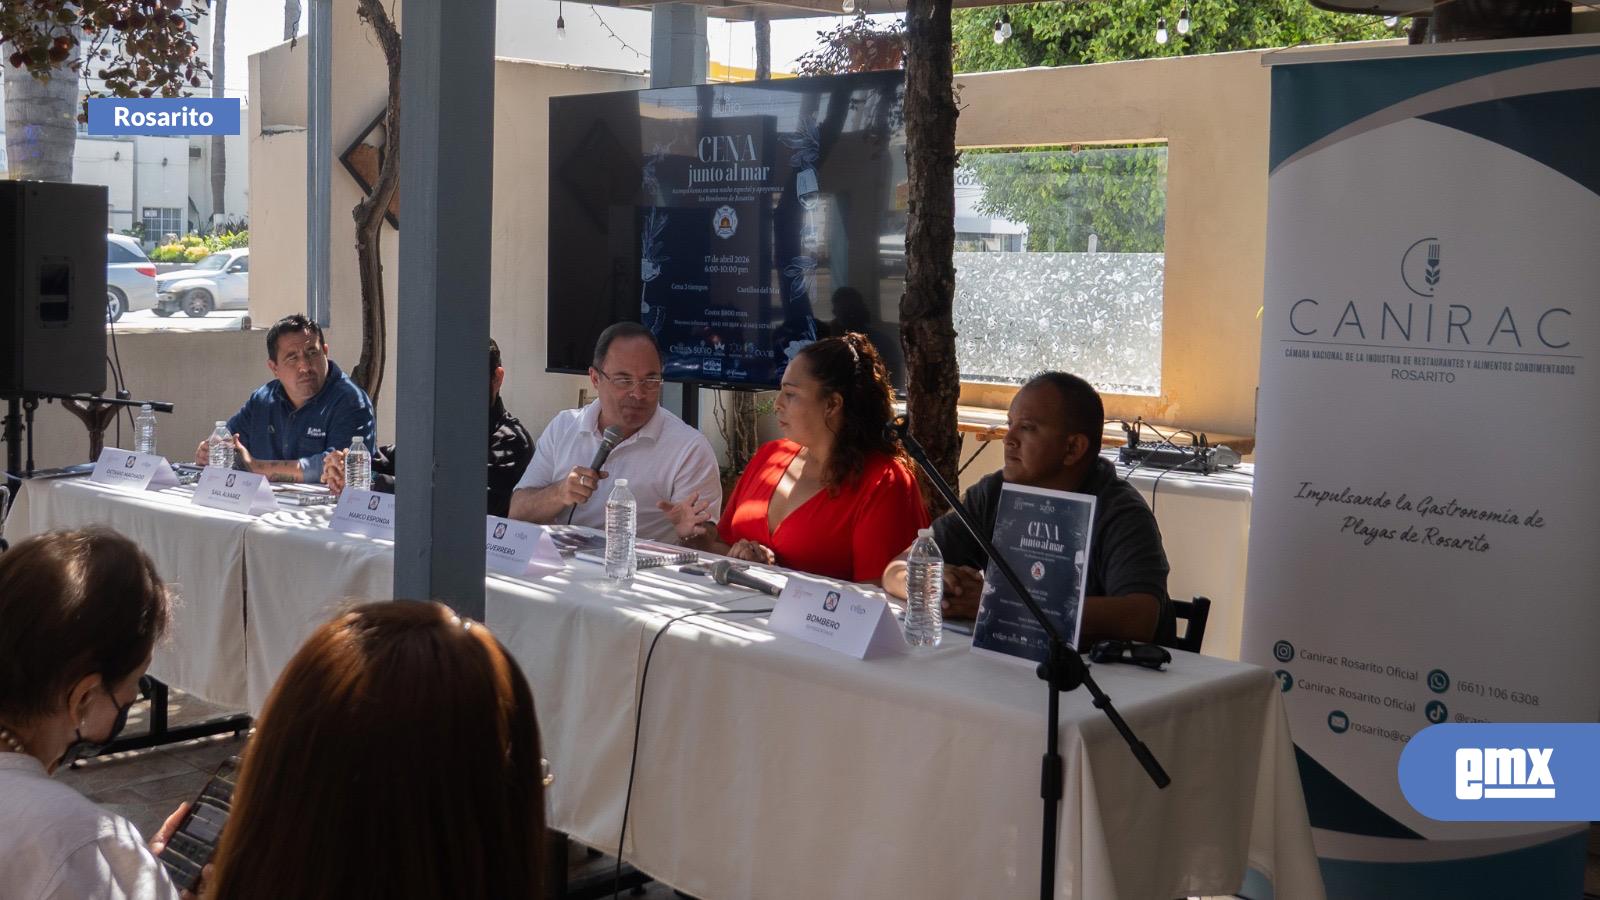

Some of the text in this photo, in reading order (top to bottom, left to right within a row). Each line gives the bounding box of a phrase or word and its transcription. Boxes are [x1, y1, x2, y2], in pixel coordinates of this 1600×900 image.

[698, 134, 757, 163] CENA
[688, 162, 770, 187] junto al mar
[719, 255, 733, 263] abril
[738, 267, 749, 276] pm
[1288, 298, 1573, 350] CANIRAC
[1285, 347, 1576, 376] CÁMARA NACIONAL DE LA INDUSTRIA DE RESTAURANTES Y ALIMENTOS CONDIMENTADOS
[1391, 368, 1456, 384] ROSARITO
[348, 510, 366, 521] MARCO
[366, 513, 390, 526] ESPONDA
[1294, 481, 1546, 529] Impulsando la Gastronomía de
[1019, 534, 1041, 548] junto
[1049, 540, 1065, 553] mar
[1027, 520, 1060, 542] CENA
[1340, 515, 1490, 553] Playas de Rosarito
[805, 612, 841, 631] BOMBERO
[1299, 649, 1419, 682] Canirac Rosarito Oficial
[1297, 678, 1417, 714] Canirac Rosarito Oficial
[1456, 680, 1541, 707] (661) 106 6308
